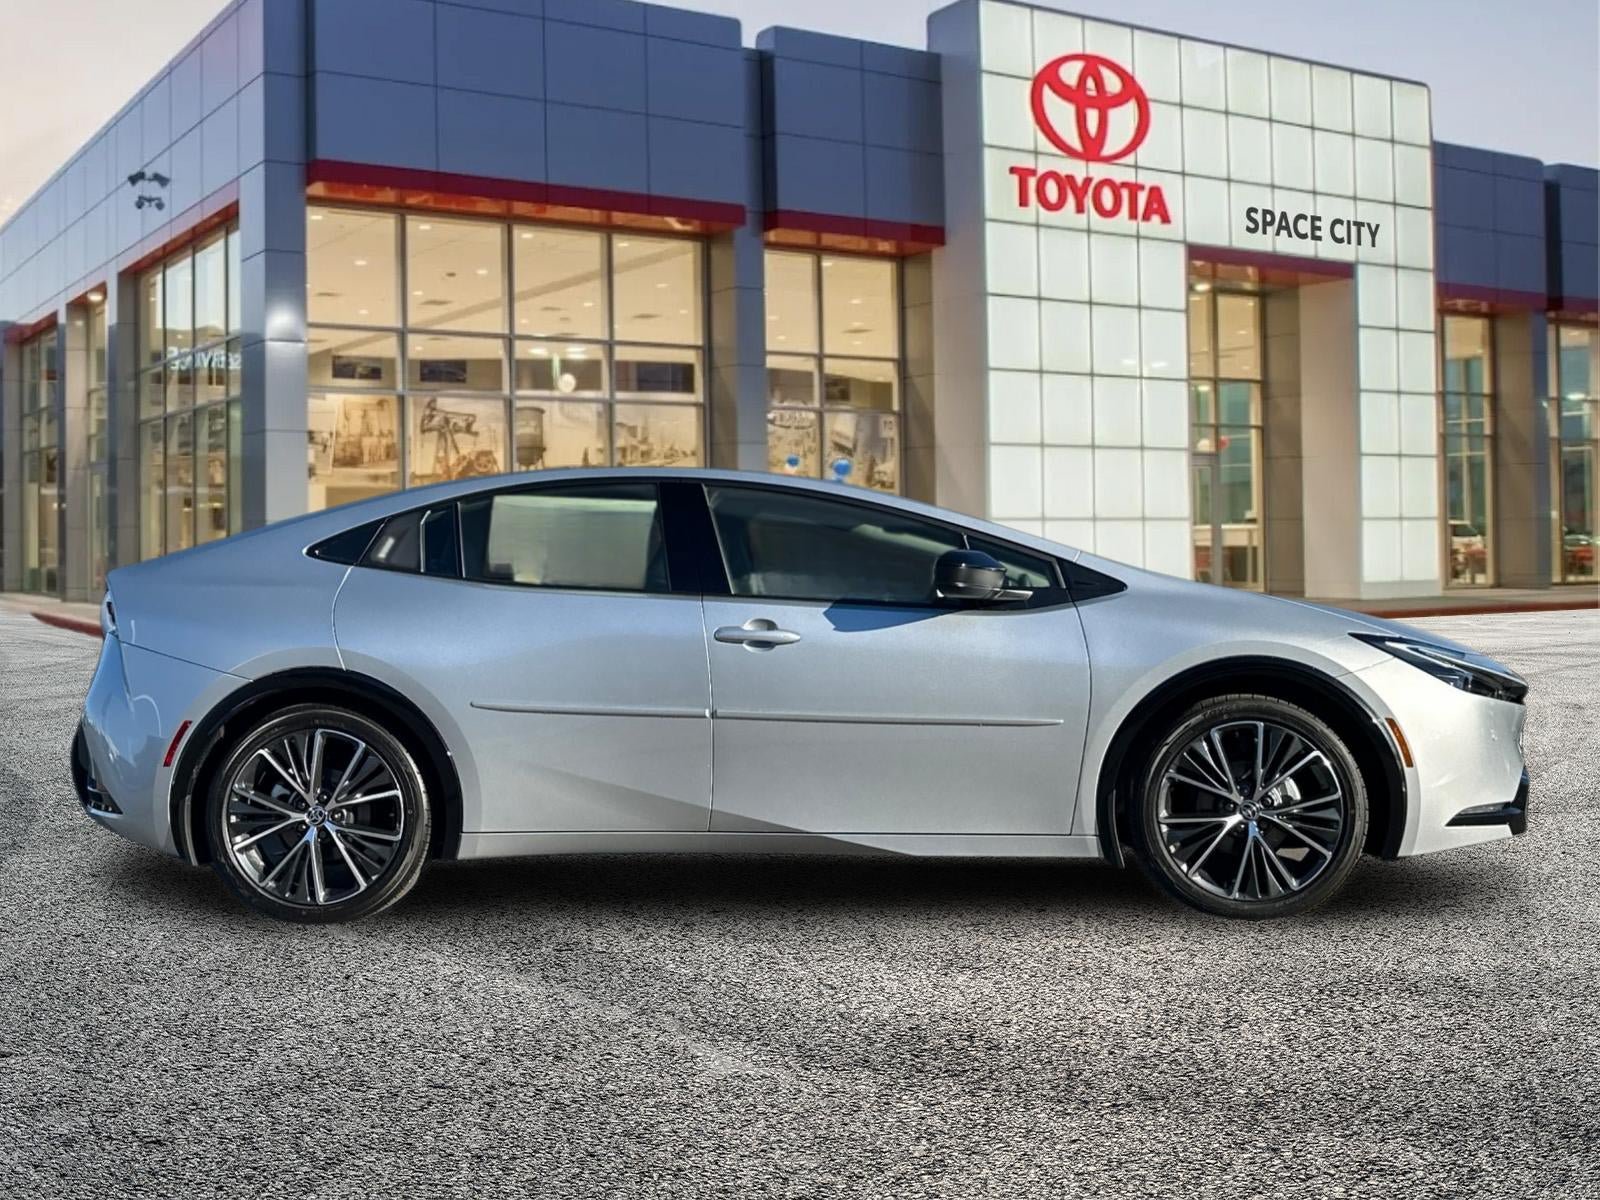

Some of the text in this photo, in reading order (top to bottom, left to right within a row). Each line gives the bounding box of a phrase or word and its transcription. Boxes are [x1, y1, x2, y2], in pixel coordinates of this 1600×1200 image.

[1009, 166, 1171, 224] TOYOTA
[1245, 206, 1381, 248] SPACE CITY
